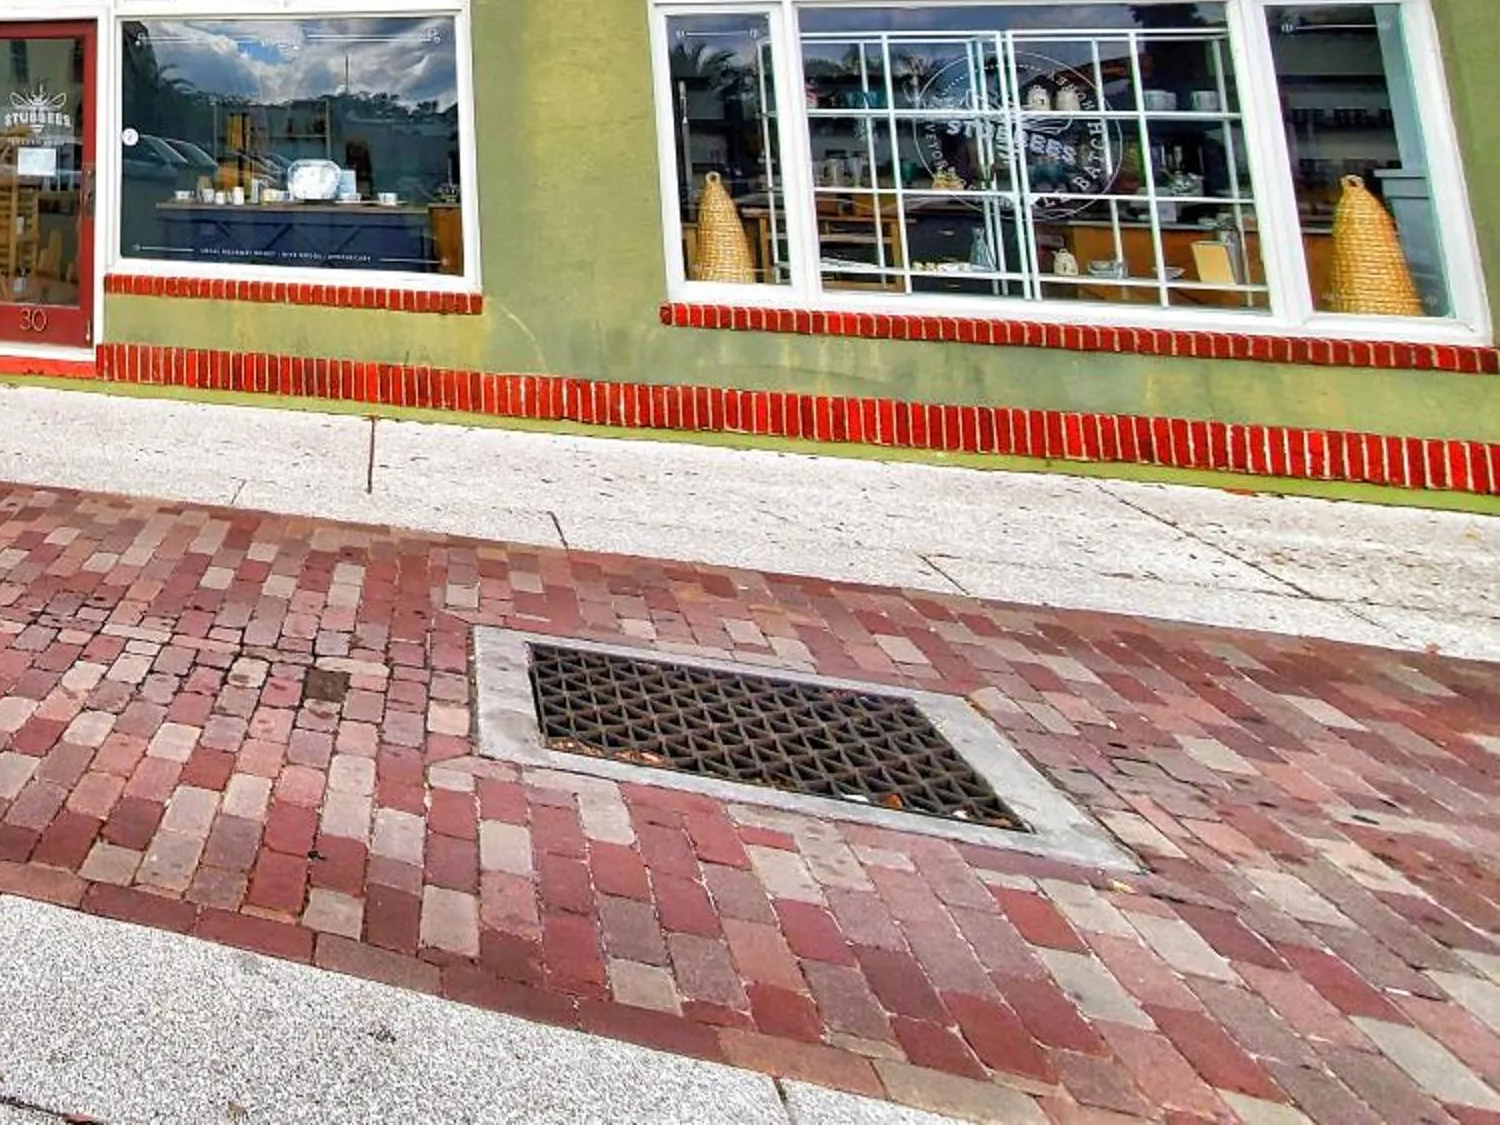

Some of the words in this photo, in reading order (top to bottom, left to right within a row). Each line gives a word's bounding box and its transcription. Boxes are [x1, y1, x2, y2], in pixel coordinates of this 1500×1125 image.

[4, 111, 72, 129] STUBBEES
[1072, 121, 1104, 192] BATCH
[19, 306, 47, 332] 30
